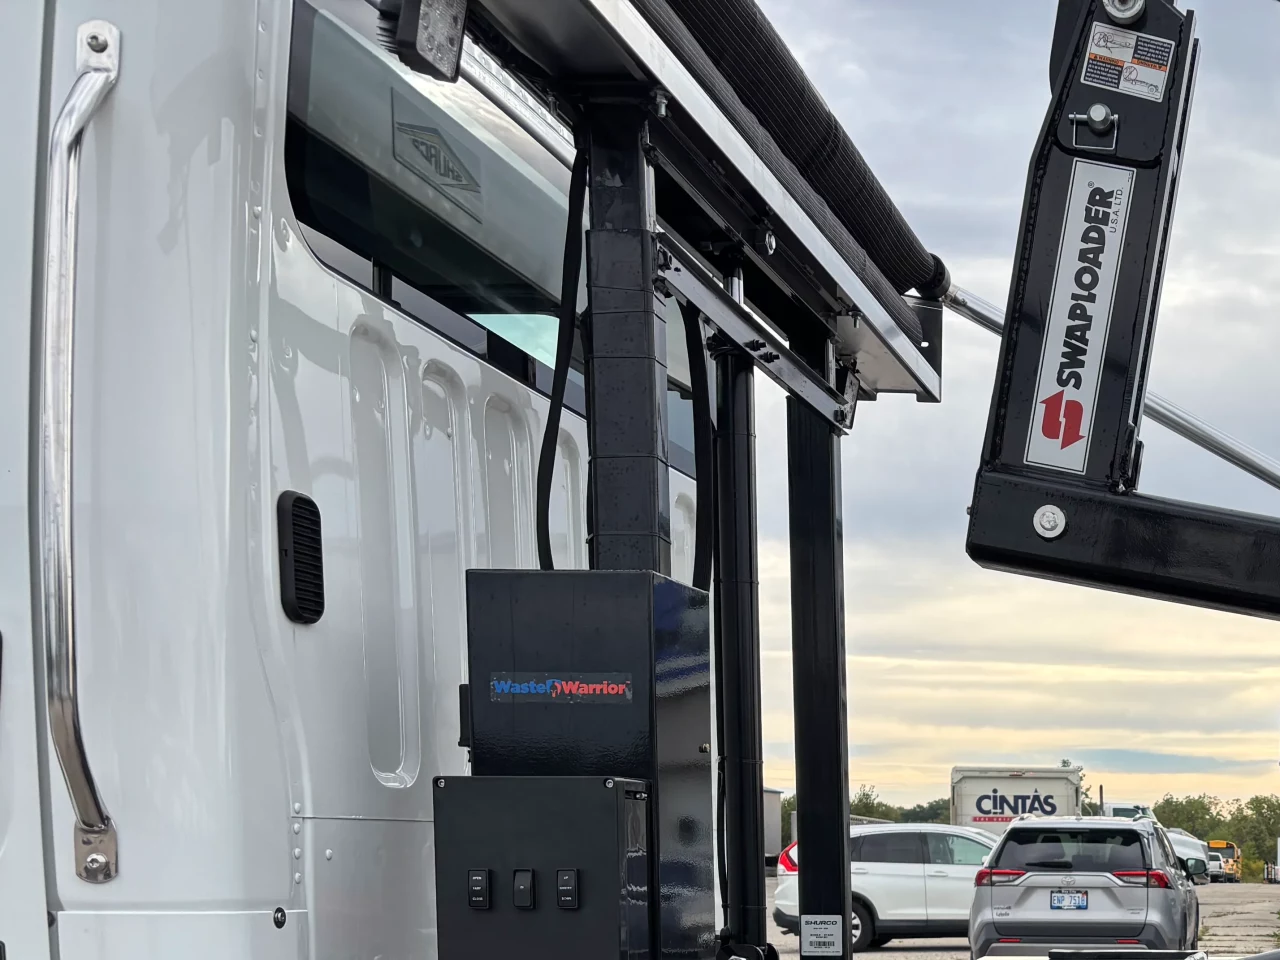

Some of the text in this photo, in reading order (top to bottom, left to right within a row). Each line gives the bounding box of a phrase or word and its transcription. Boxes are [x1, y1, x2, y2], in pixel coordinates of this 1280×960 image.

[1108, 186, 1124, 234] U.S.A. LTD.
[1056, 185, 1115, 391] SWAPLOADER
[493, 680, 626, 695] Waste Warrior
